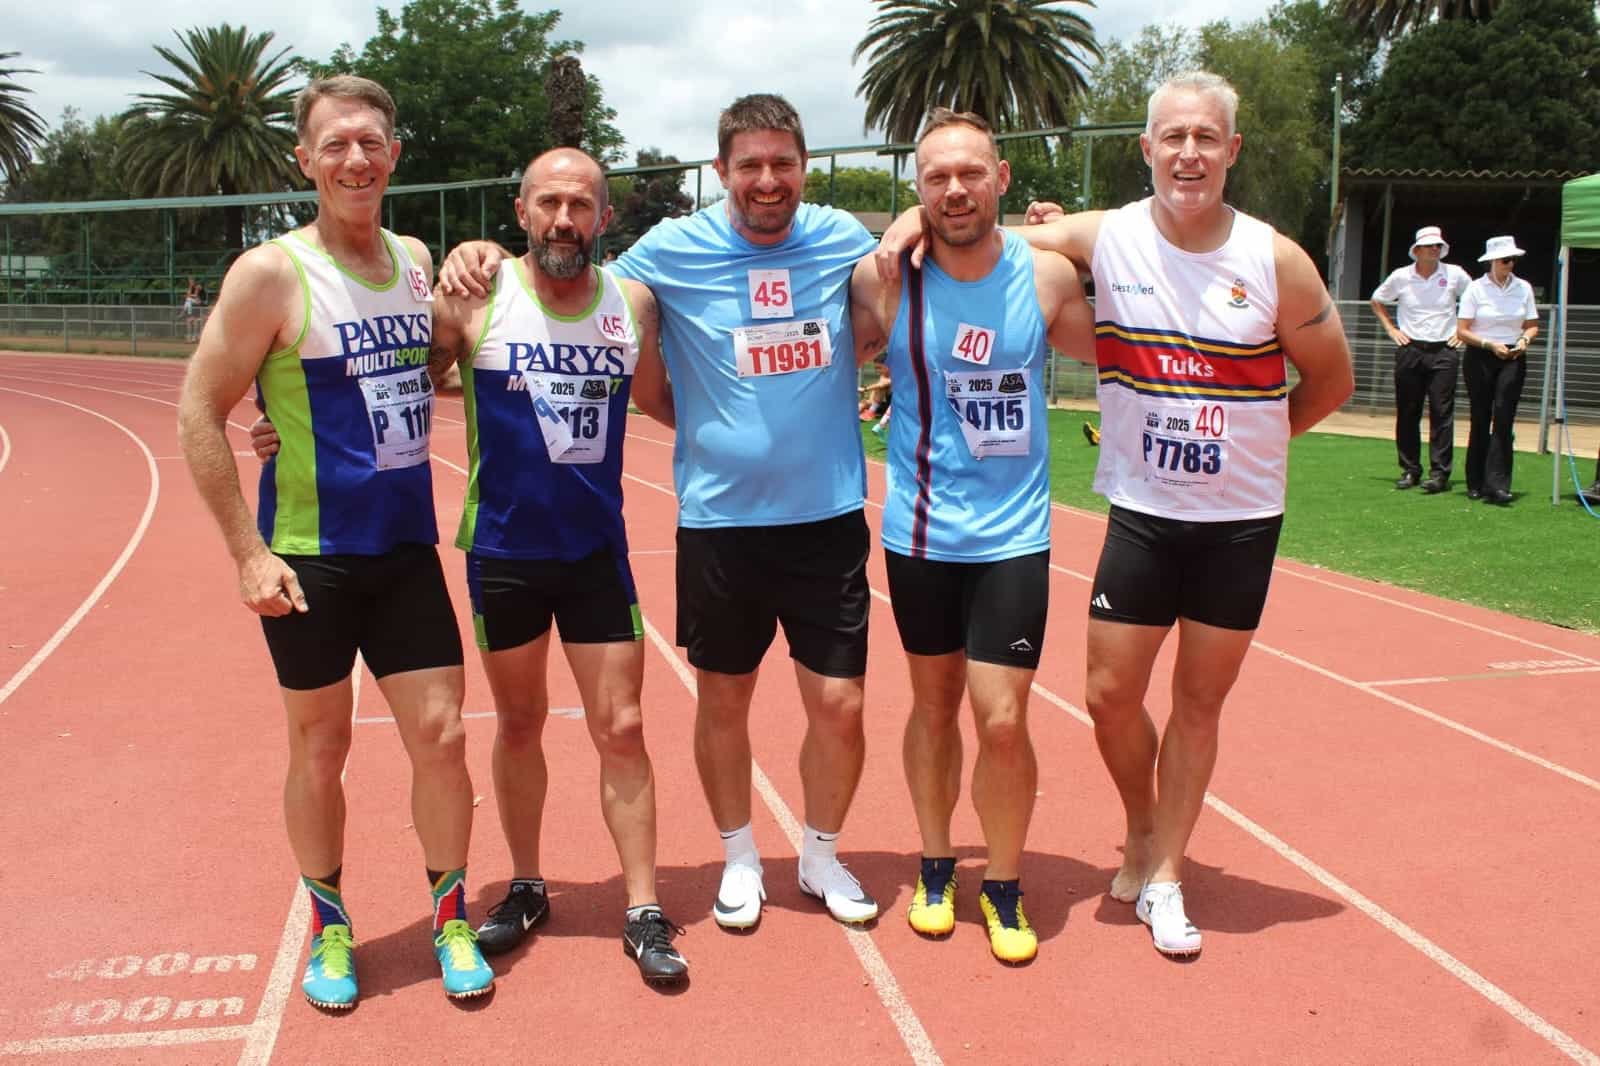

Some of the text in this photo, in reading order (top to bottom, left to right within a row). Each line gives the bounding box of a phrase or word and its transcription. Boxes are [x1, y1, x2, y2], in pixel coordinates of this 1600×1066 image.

[408, 267, 427, 297] 45
[754, 281, 787, 306] 45
[333, 313, 430, 356] PARYS
[603, 316, 626, 338] 45
[748, 339, 822, 375] T1931
[958, 329, 988, 361] 40
[505, 342, 625, 376] PARYS
[1158, 354, 1215, 378] Tuks
[397, 379, 420, 396] 2025
[550, 382, 575, 396] 2025
[583, 381, 607, 391] ASA
[969, 379, 992, 392] 2025
[1002, 375, 1024, 385] ASA
[372, 410, 389, 444] P
[966, 400, 1023, 431] 4715
[1166, 416, 1190, 432] 2025
[1195, 405, 1224, 437] 40
[1155, 437, 1221, 475] 7783
